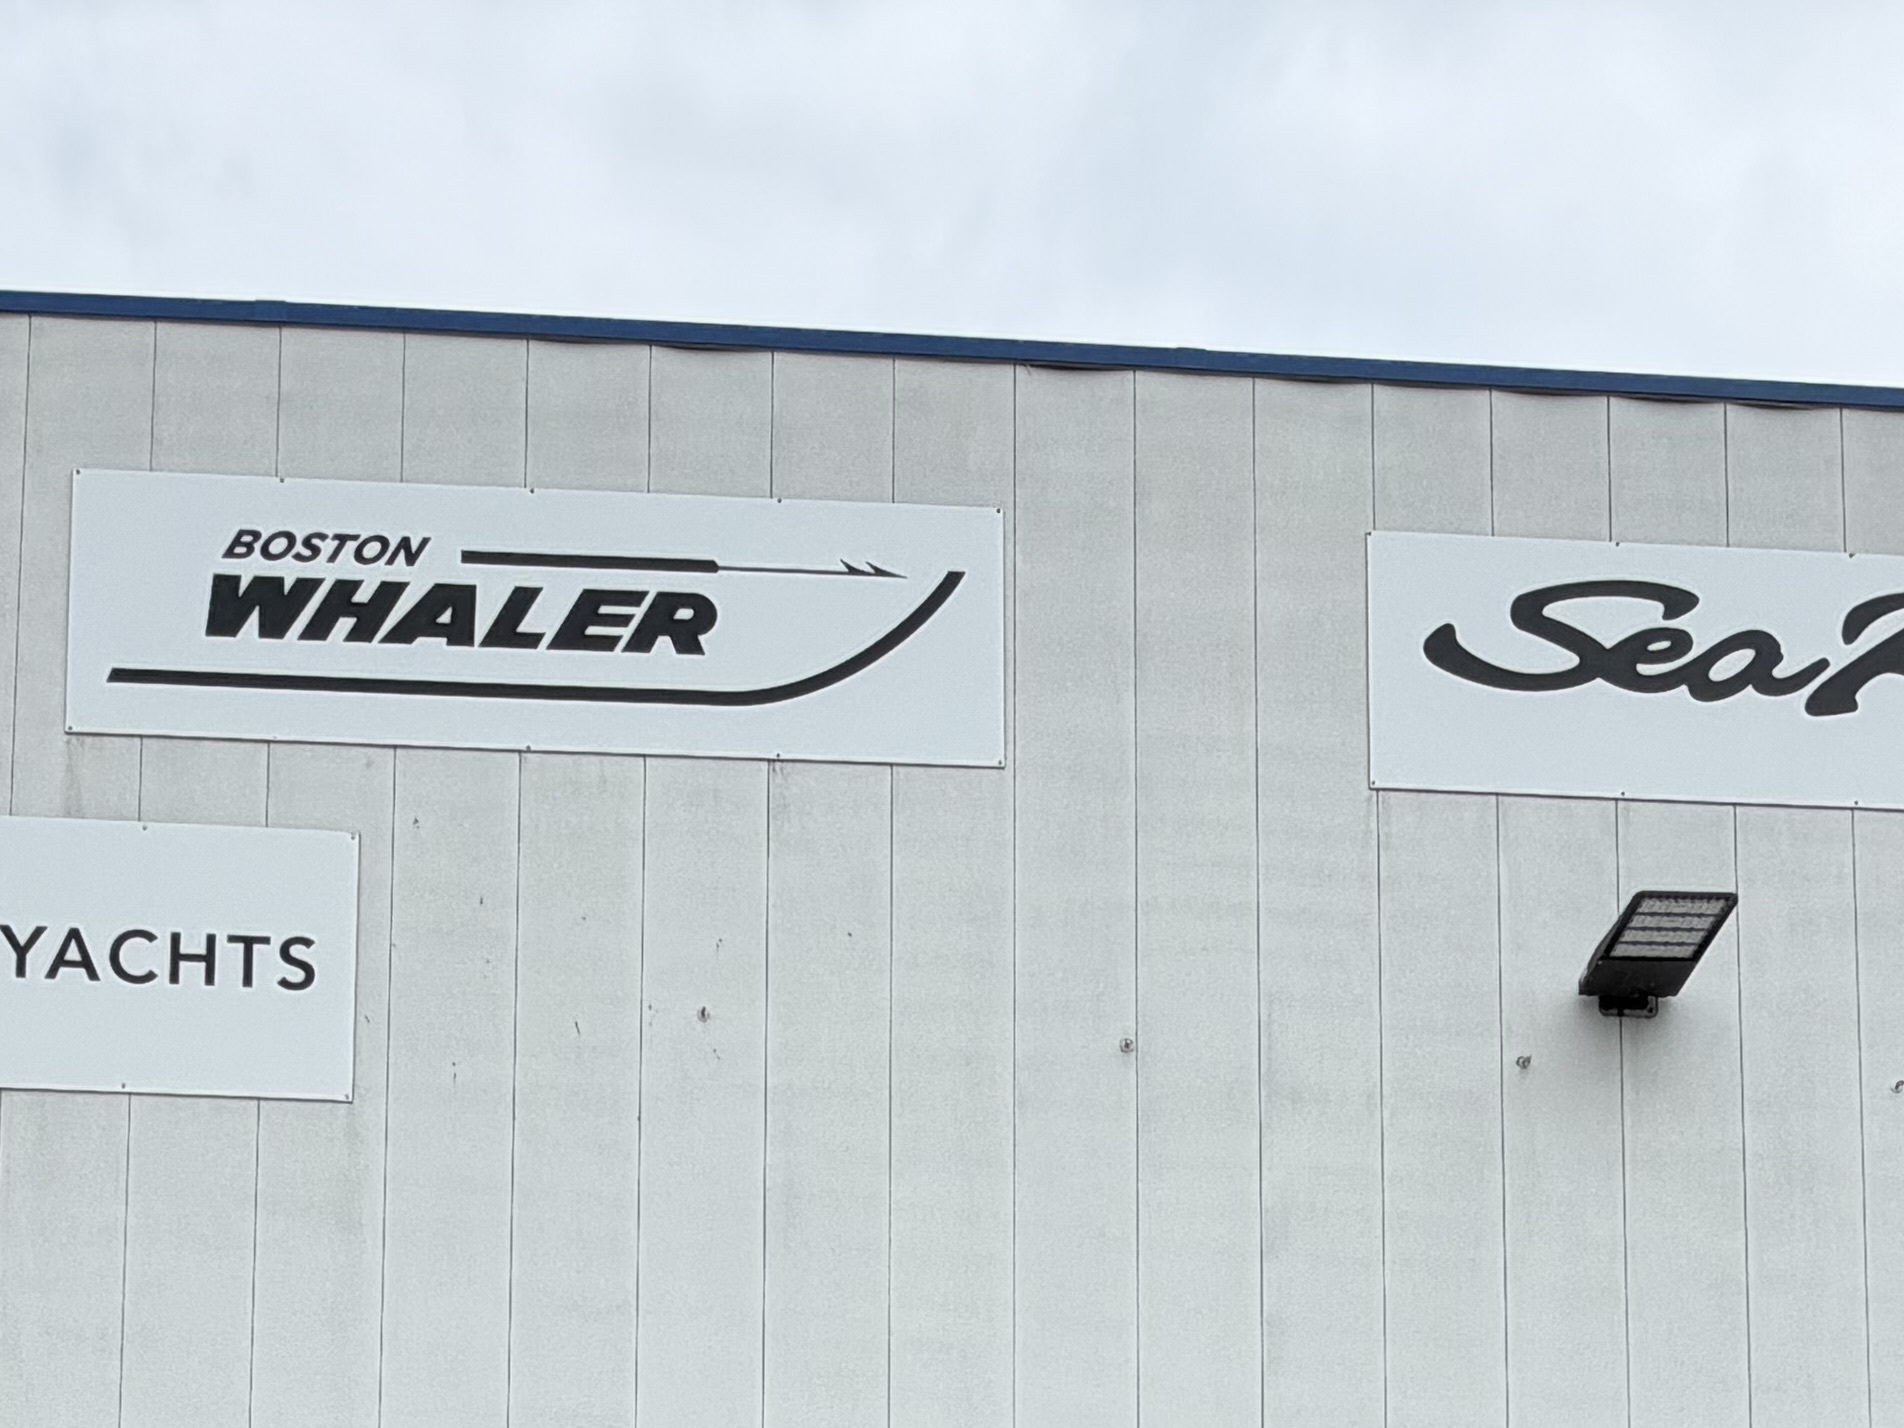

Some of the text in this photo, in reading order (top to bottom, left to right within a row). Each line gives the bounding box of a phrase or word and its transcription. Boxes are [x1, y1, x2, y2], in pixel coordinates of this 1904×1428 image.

[222, 529, 431, 567] BOSTON
[205, 573, 718, 656] WHALER
[1423, 579, 1831, 703] Sea
